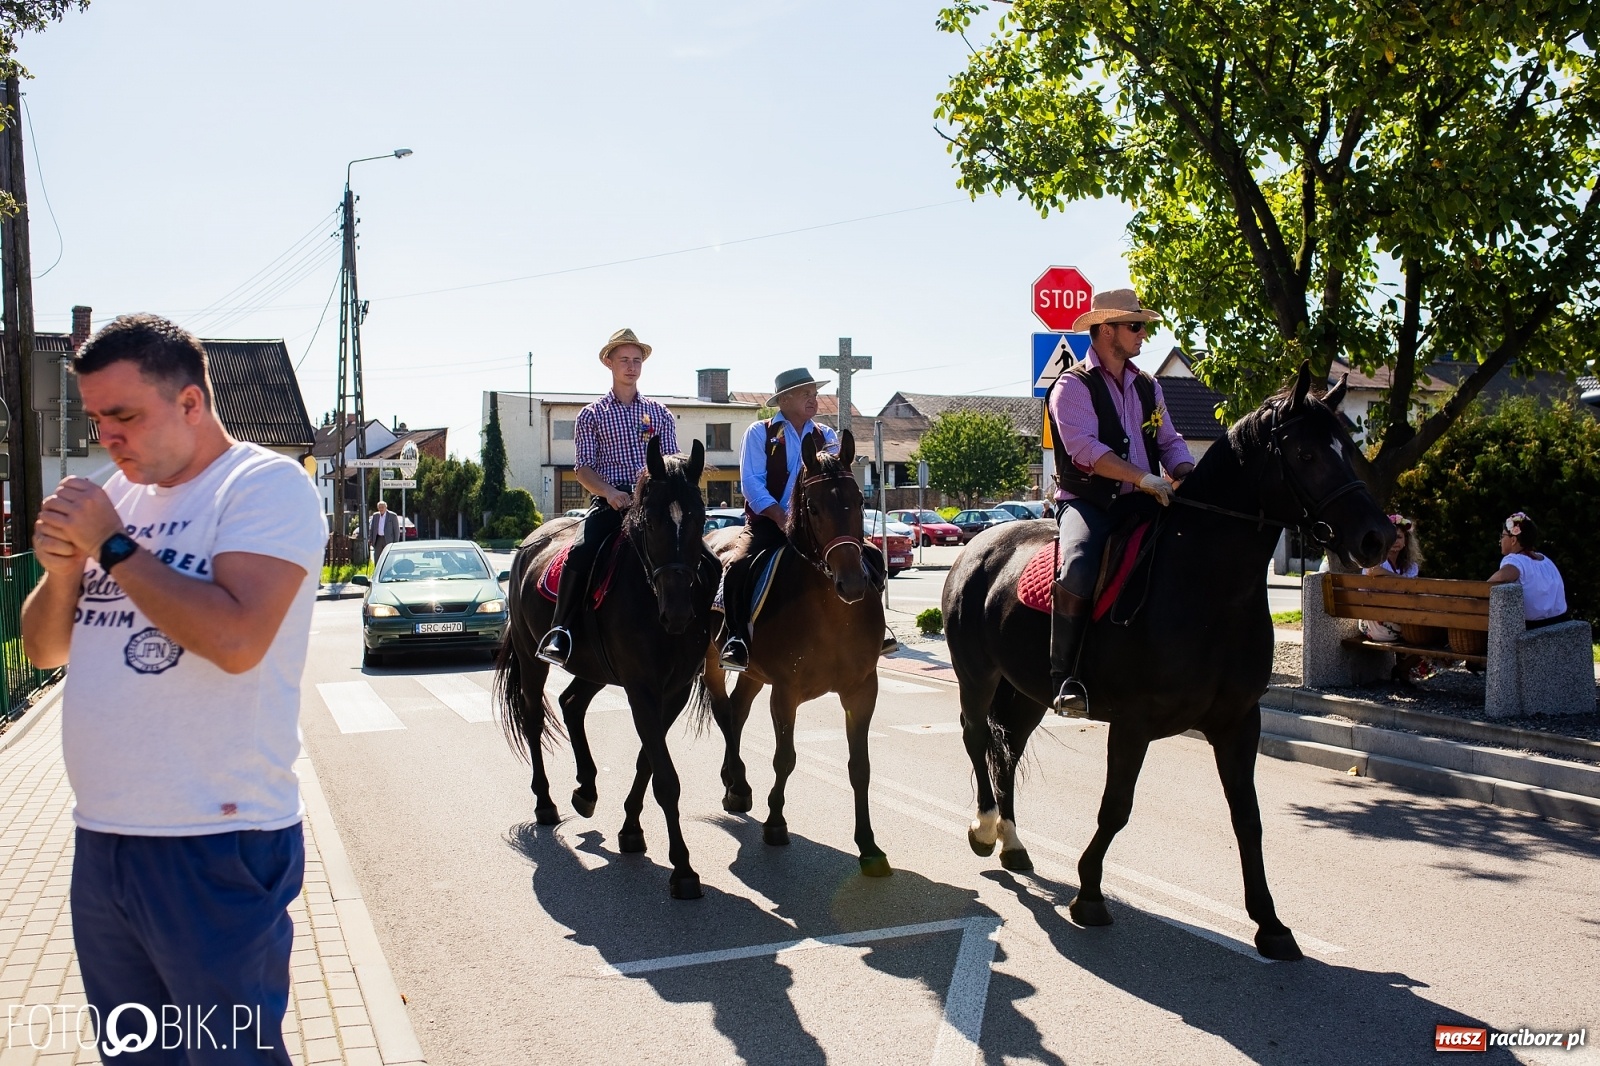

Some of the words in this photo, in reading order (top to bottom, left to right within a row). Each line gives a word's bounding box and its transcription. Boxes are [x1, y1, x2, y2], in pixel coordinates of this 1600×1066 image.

[1039, 289, 1088, 310] STOP
[74, 605, 135, 628] DENIM
[420, 623, 439, 633] SRC
[441, 622, 462, 632] 6H70
[136, 642, 167, 658] JPN
